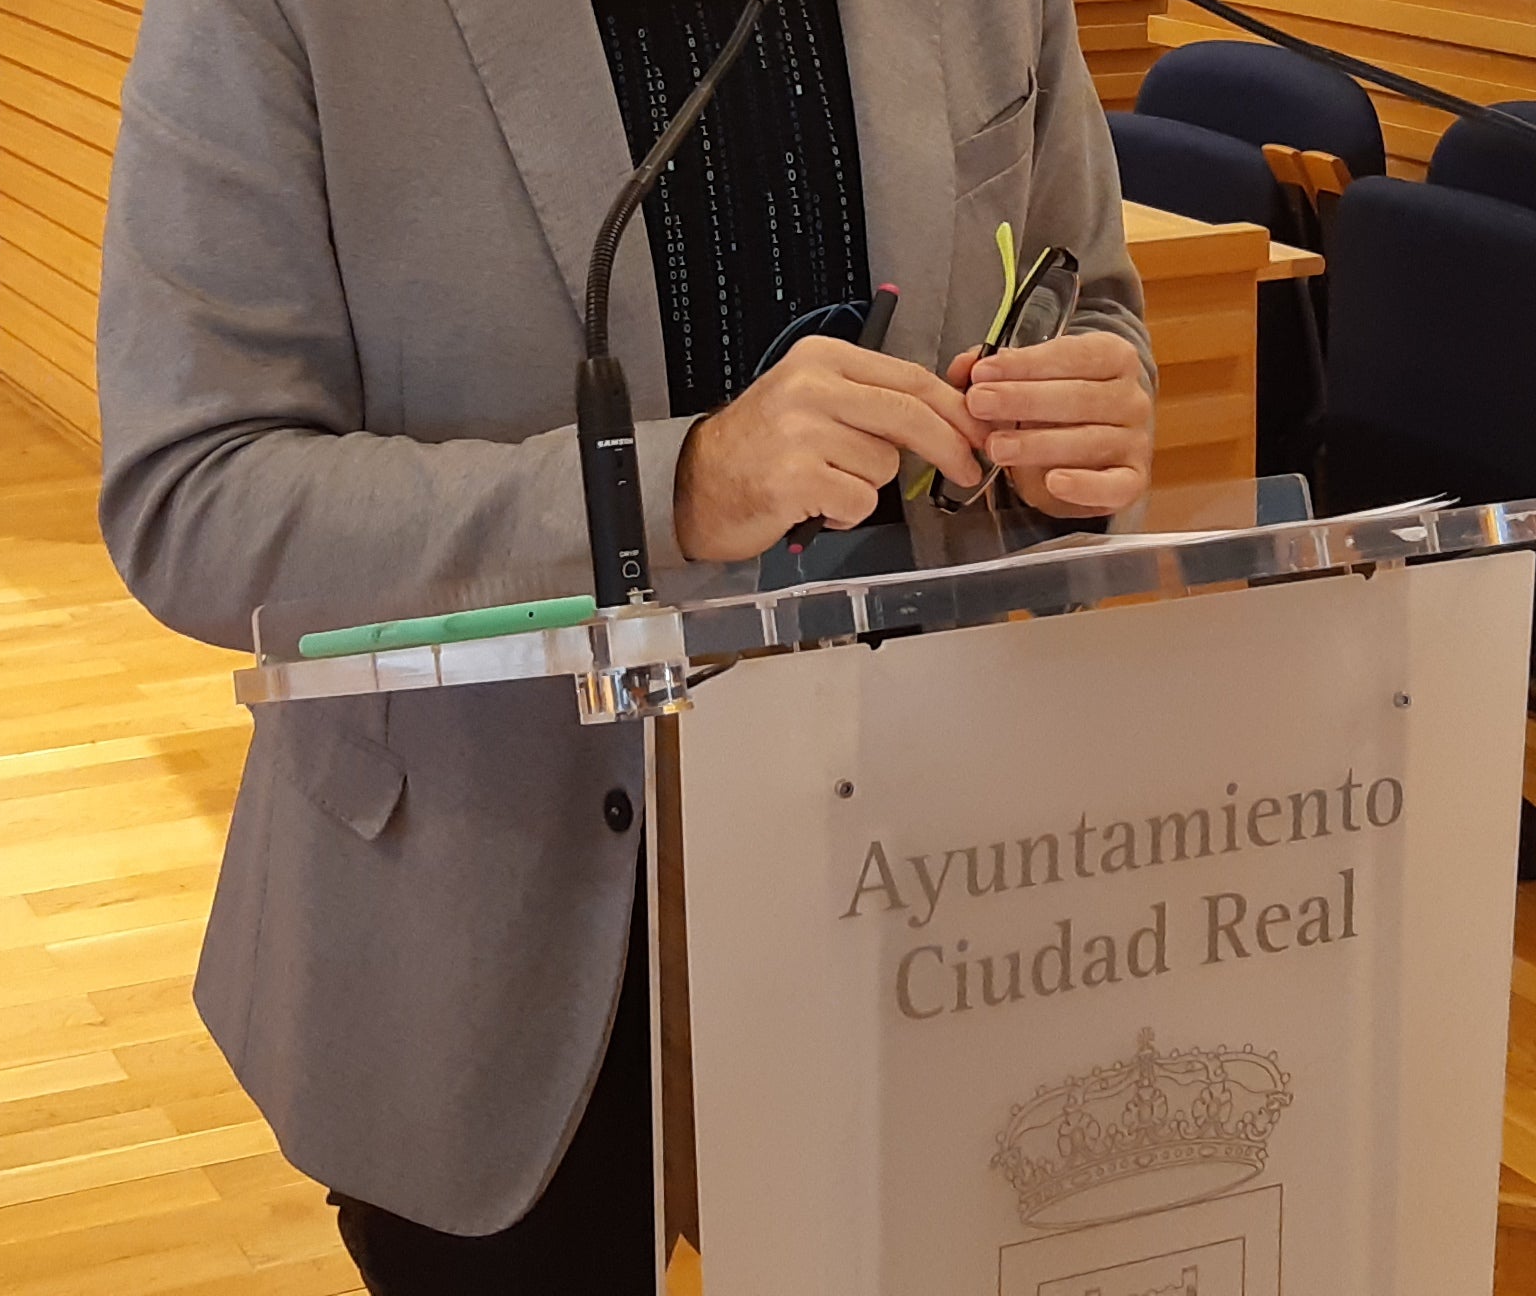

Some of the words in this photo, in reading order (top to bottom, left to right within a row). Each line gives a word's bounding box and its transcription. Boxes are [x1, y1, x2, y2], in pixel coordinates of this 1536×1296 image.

[838, 768, 1404, 928] Ayuntamiento
[895, 902, 1171, 1020] Ciudad
[1201, 867, 1359, 965] Real
